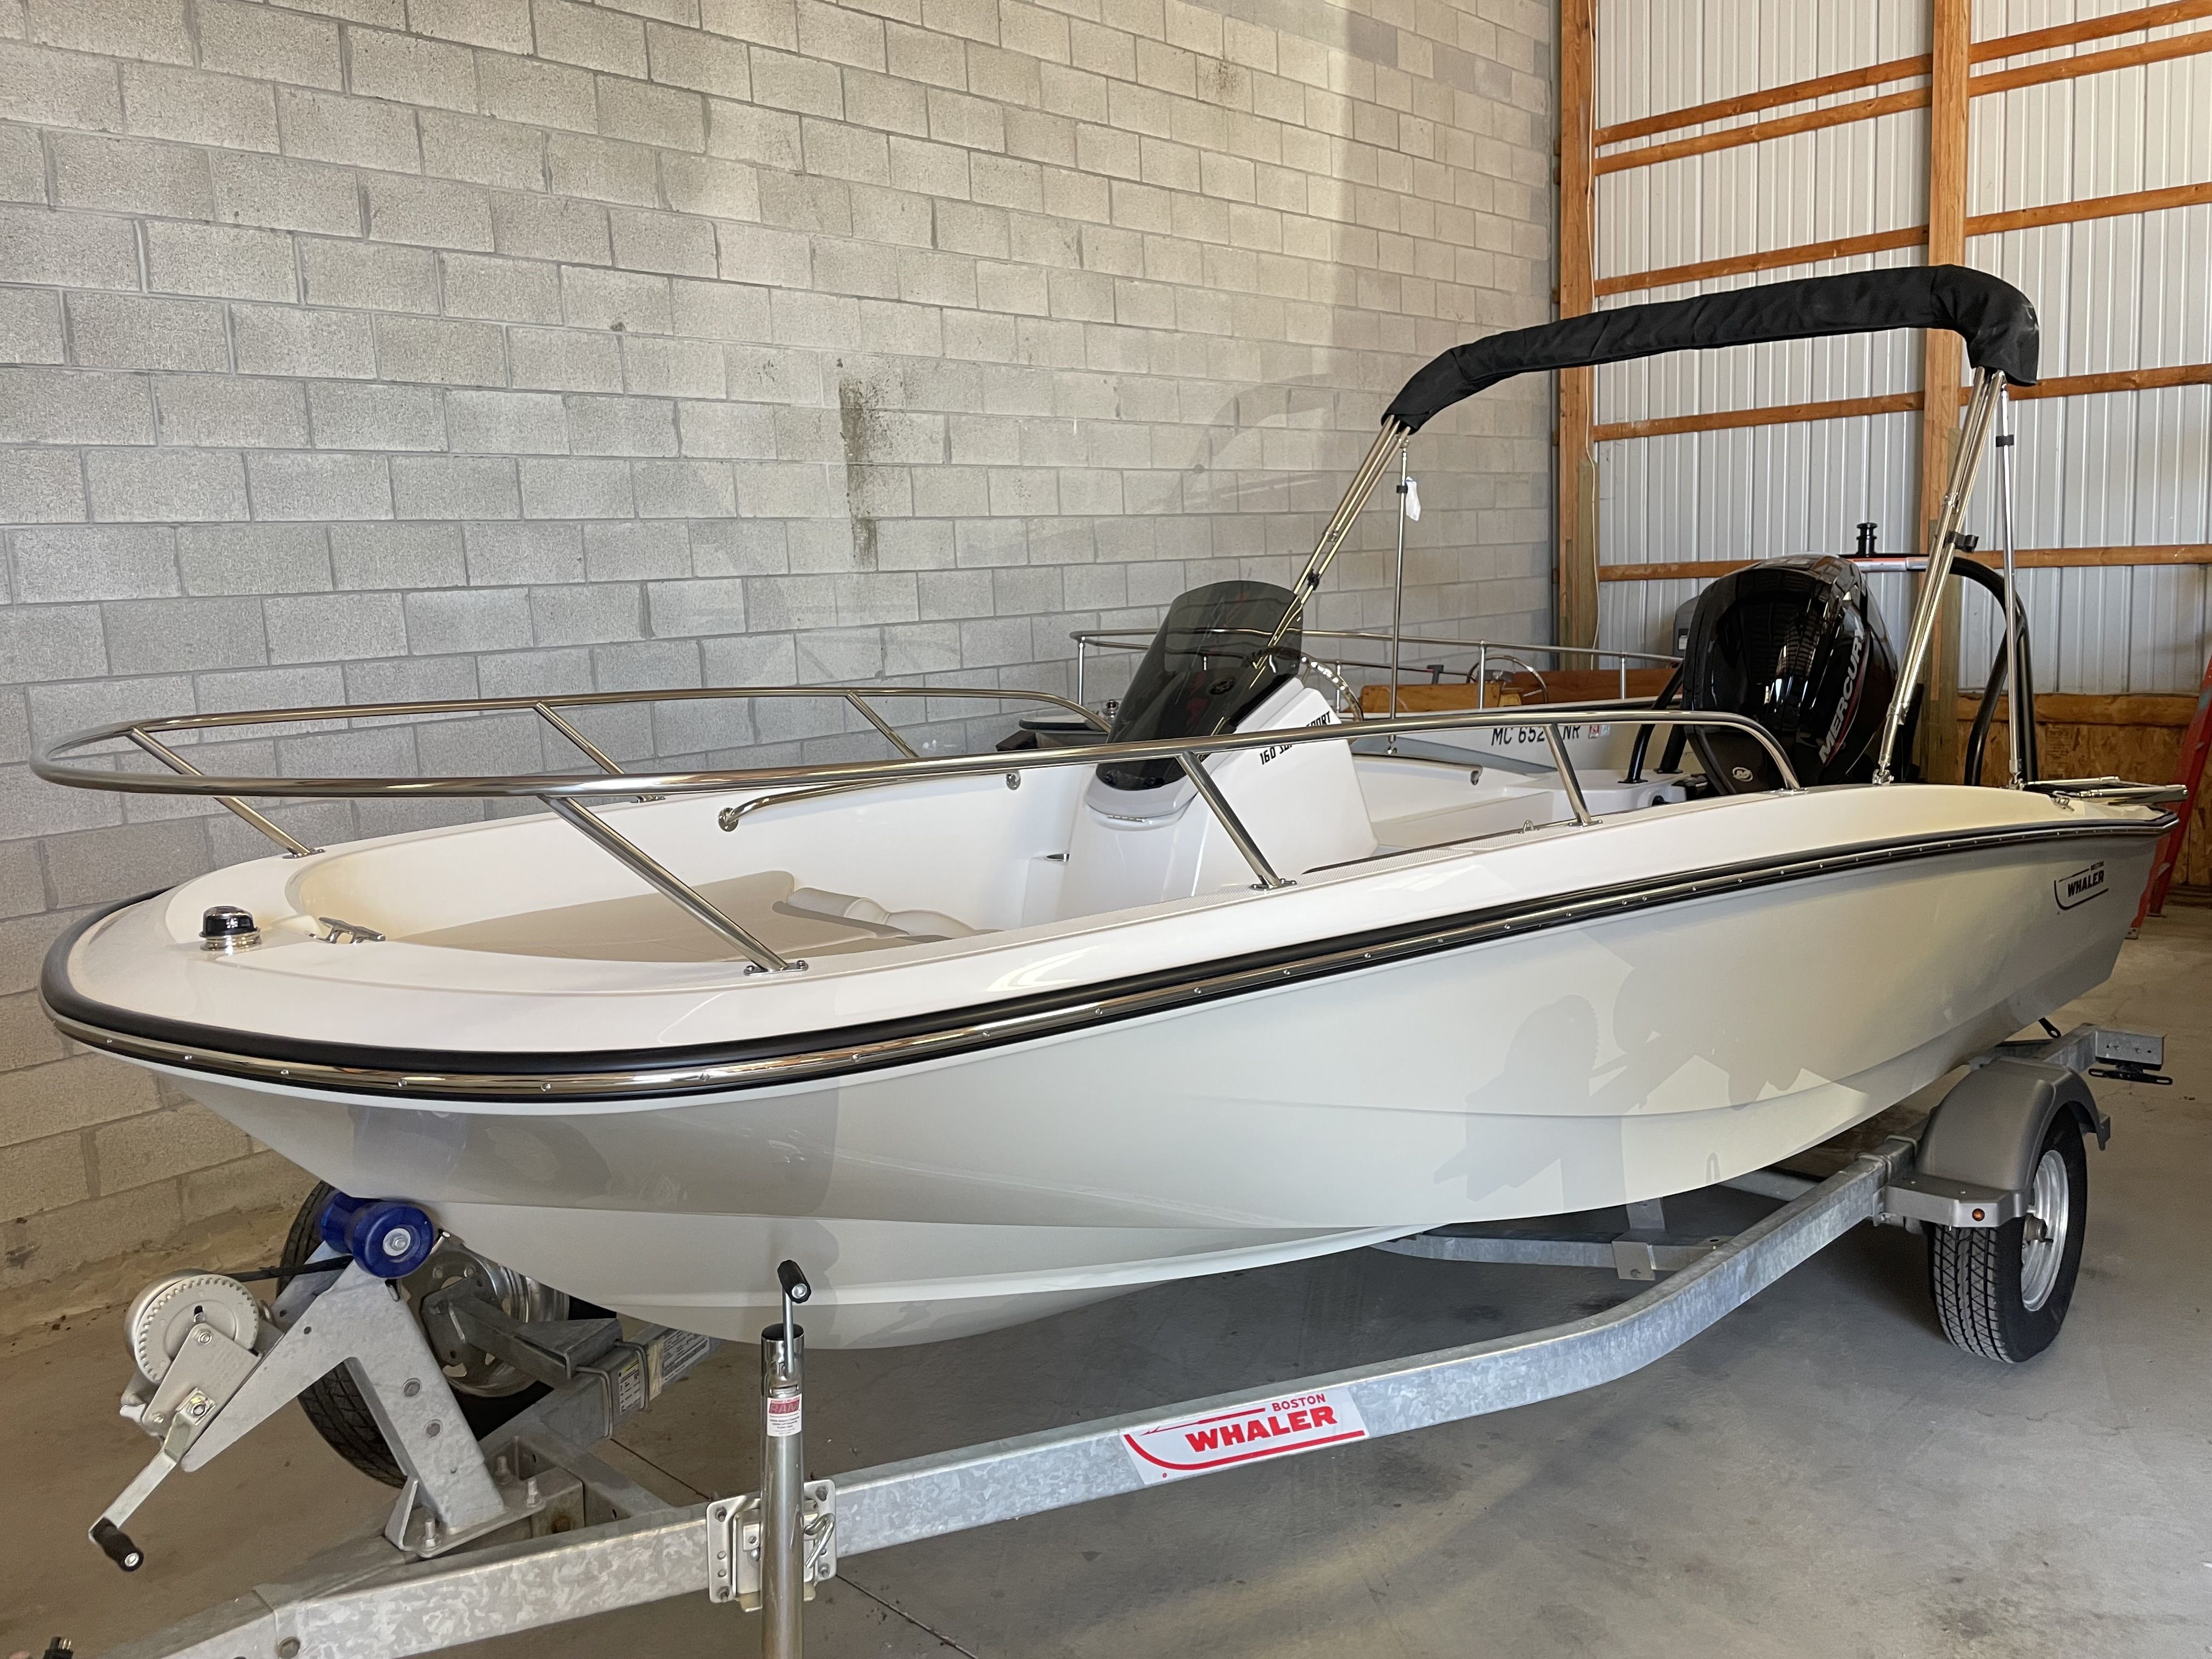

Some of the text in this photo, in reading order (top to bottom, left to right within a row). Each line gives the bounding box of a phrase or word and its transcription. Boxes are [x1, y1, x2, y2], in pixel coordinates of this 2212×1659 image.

[1819, 616, 1864, 764] MERCURY
[1260, 746, 1277, 765] 160
[1306, 711, 1330, 727] PORT
[1491, 727, 1513, 746] MC
[1563, 725, 1581, 740] NR
[2068, 870, 2104, 898] WHALER
[770, 1401, 799, 1414] RAM
[1272, 1393, 1326, 1412] BOSTON
[1185, 1406, 1338, 1453] WHALER
